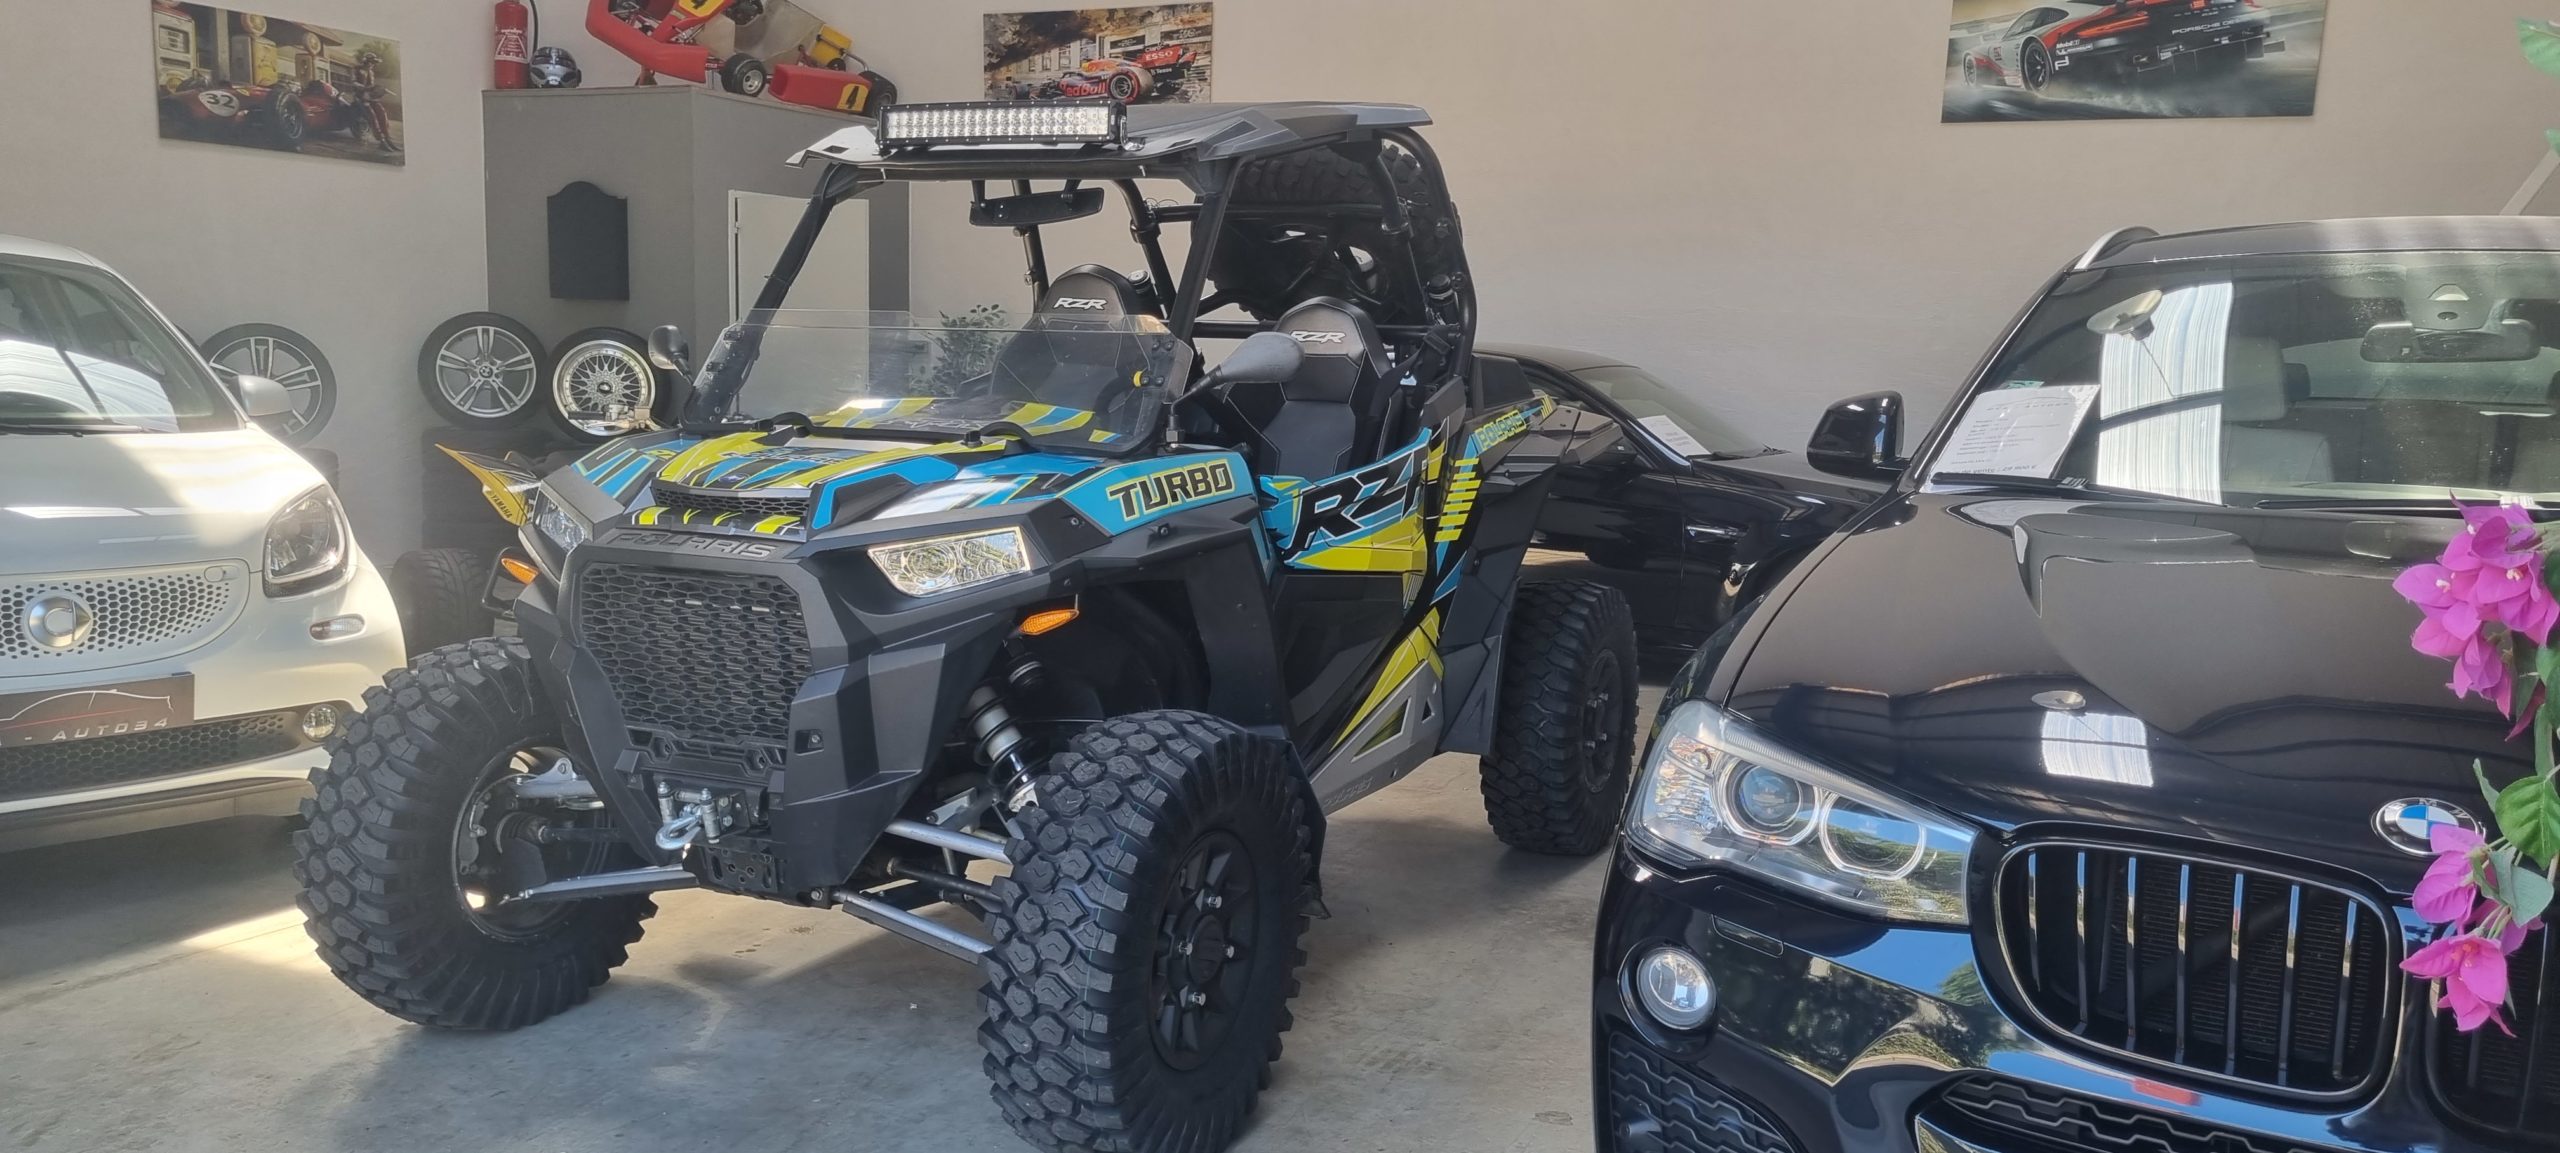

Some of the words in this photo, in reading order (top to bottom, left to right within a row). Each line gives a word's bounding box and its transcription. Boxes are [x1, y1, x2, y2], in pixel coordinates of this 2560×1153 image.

[2171, 22, 2220, 34] PORSCHE
[1145, 50, 1173, 60] ESSO
[205, 93, 235, 109] 32
[846, 86, 860, 109] 4
[1053, 297, 1107, 310] RZR
[1290, 330, 1346, 344] RZR
[1475, 409, 1527, 451] POLARIS
[1107, 461, 1233, 520] TURBO
[491, 494, 513, 518] YAMAHA
[607, 533, 777, 558] POLARIS
[52, 718, 168, 741] AUTO34
